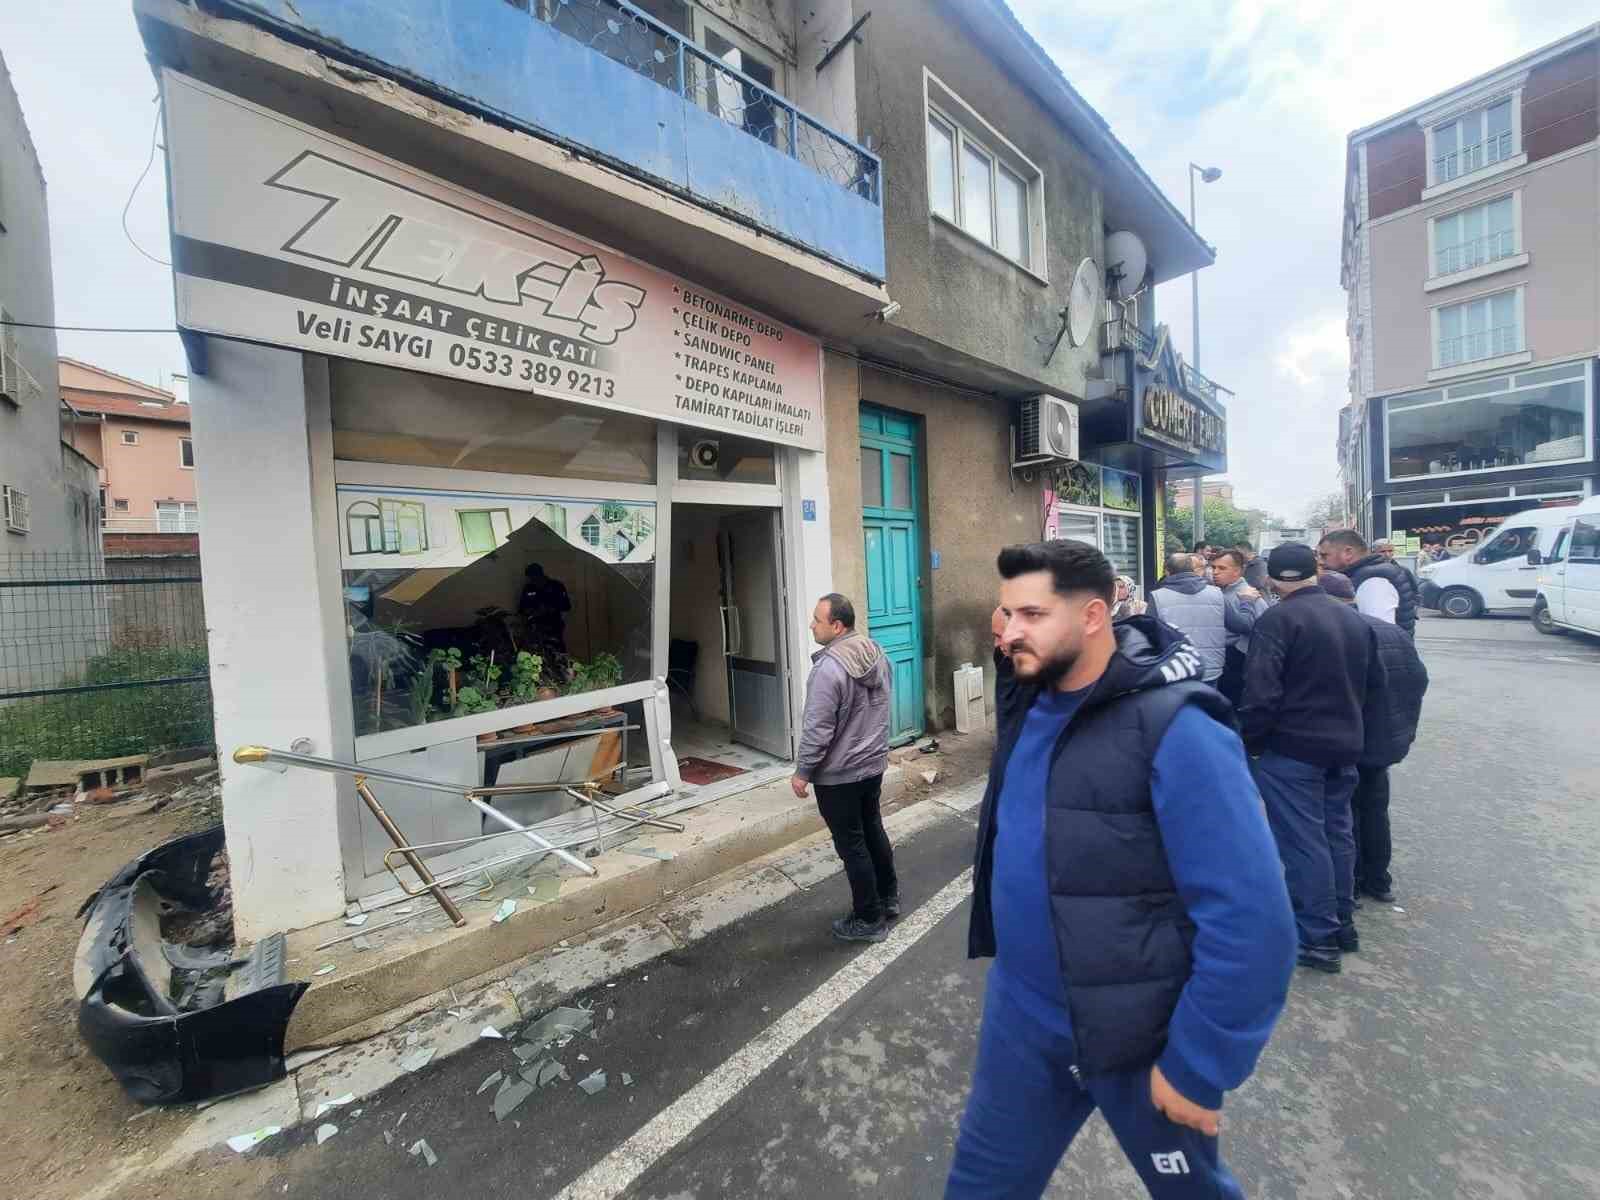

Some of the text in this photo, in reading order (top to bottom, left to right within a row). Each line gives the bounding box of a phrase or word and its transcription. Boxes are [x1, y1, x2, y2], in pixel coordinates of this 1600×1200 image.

[330, 277, 598, 367] İNŞAAT ÇELİK ÇATI
[682, 290, 785, 342] BETONARME DEPO
[682, 311, 751, 347] ÇELİK DEPO
[296, 308, 615, 398] Veli SAYGI 0533 389 9213
[744, 353, 776, 376] PANEL
[684, 354, 783, 397] TRAPES KAPLAMA
[685, 376, 720, 397] DEPO
[722, 386, 772, 412] KAPILARI
[675, 394, 730, 420] TAMİRAT
[731, 409, 776, 432] TADİLAT
